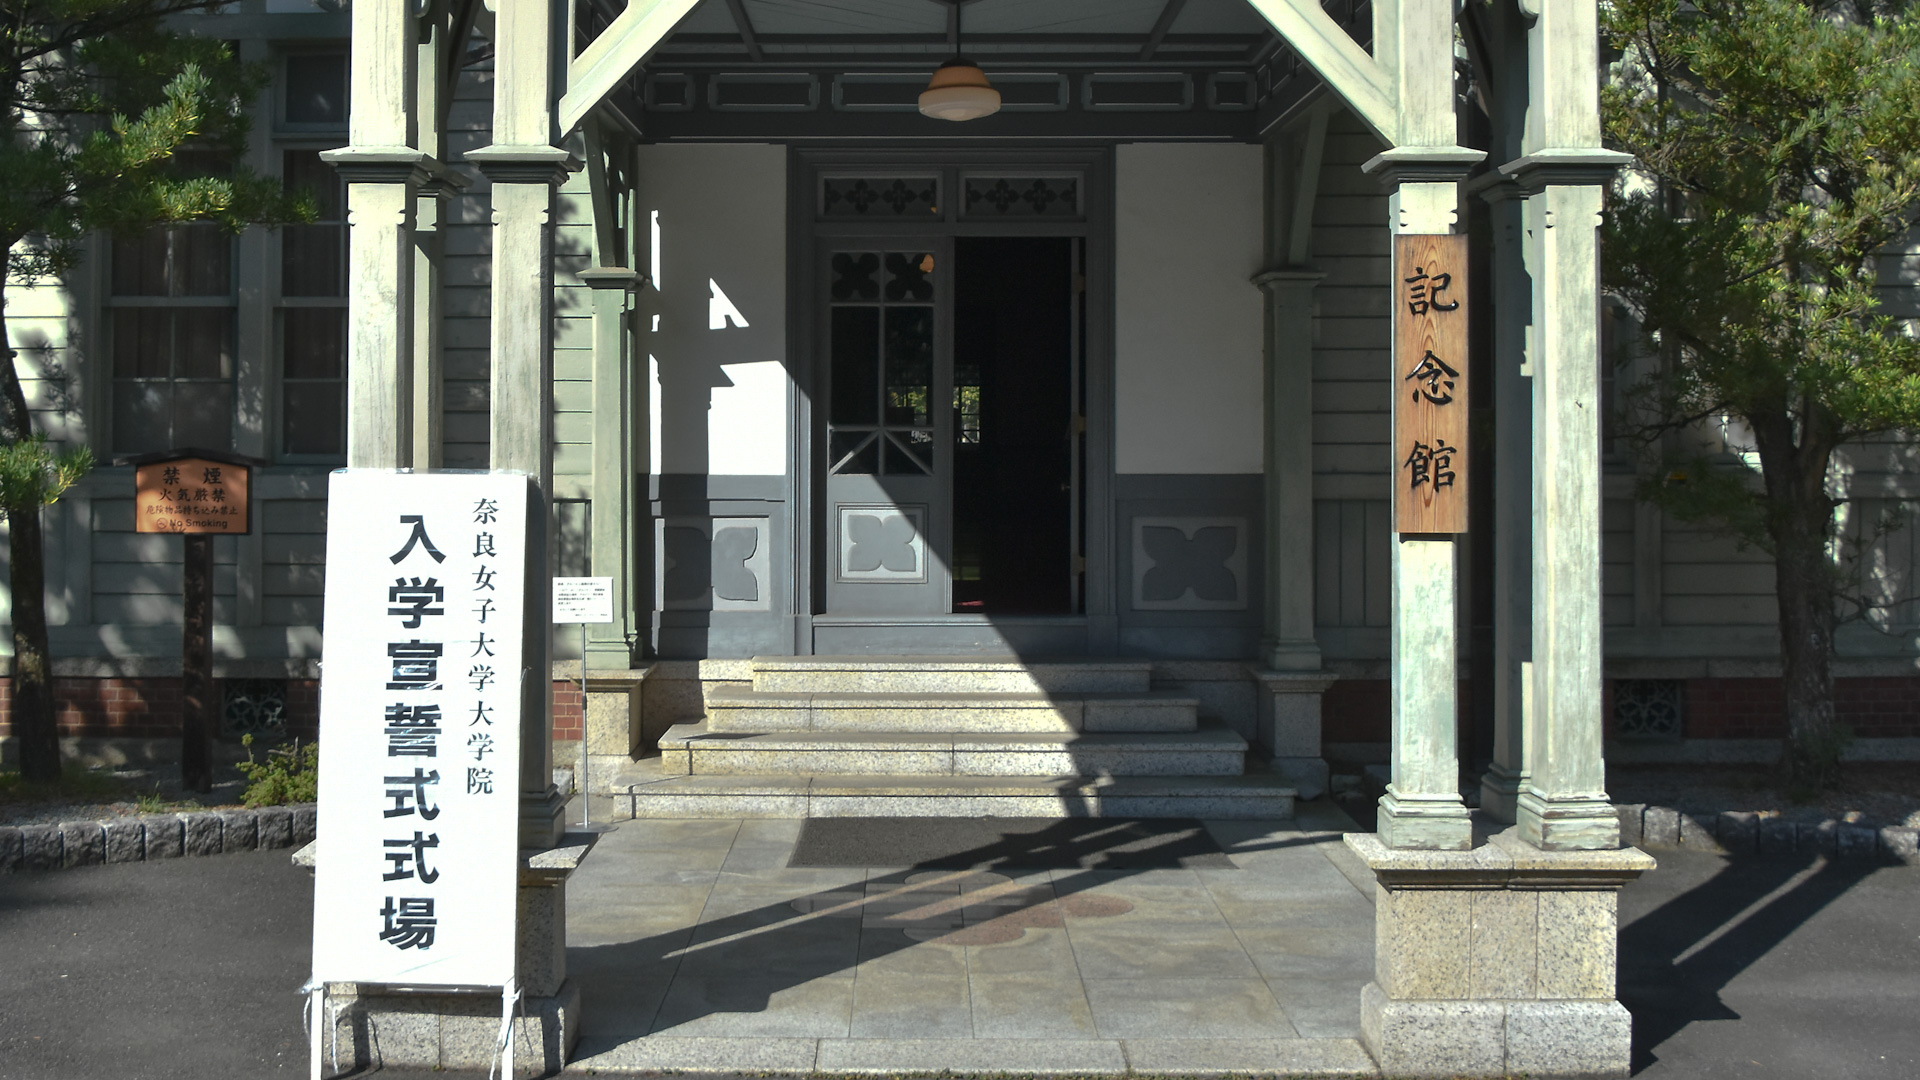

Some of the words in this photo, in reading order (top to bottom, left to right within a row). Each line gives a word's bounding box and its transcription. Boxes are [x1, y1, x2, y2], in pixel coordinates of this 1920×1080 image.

[1404, 267, 1459, 492] 記念館
[163, 467, 222, 485] 禁煙
[160, 488, 226, 502] 火気厳禁
[146, 505, 238, 515] 危険物品持ち込み禁止
[170, 519, 183, 527] No
[186, 518, 228, 529] Smoking
[466, 498, 499, 795] 奈良女子大学大学院
[379, 514, 446, 951] 入学宣誓式式場
